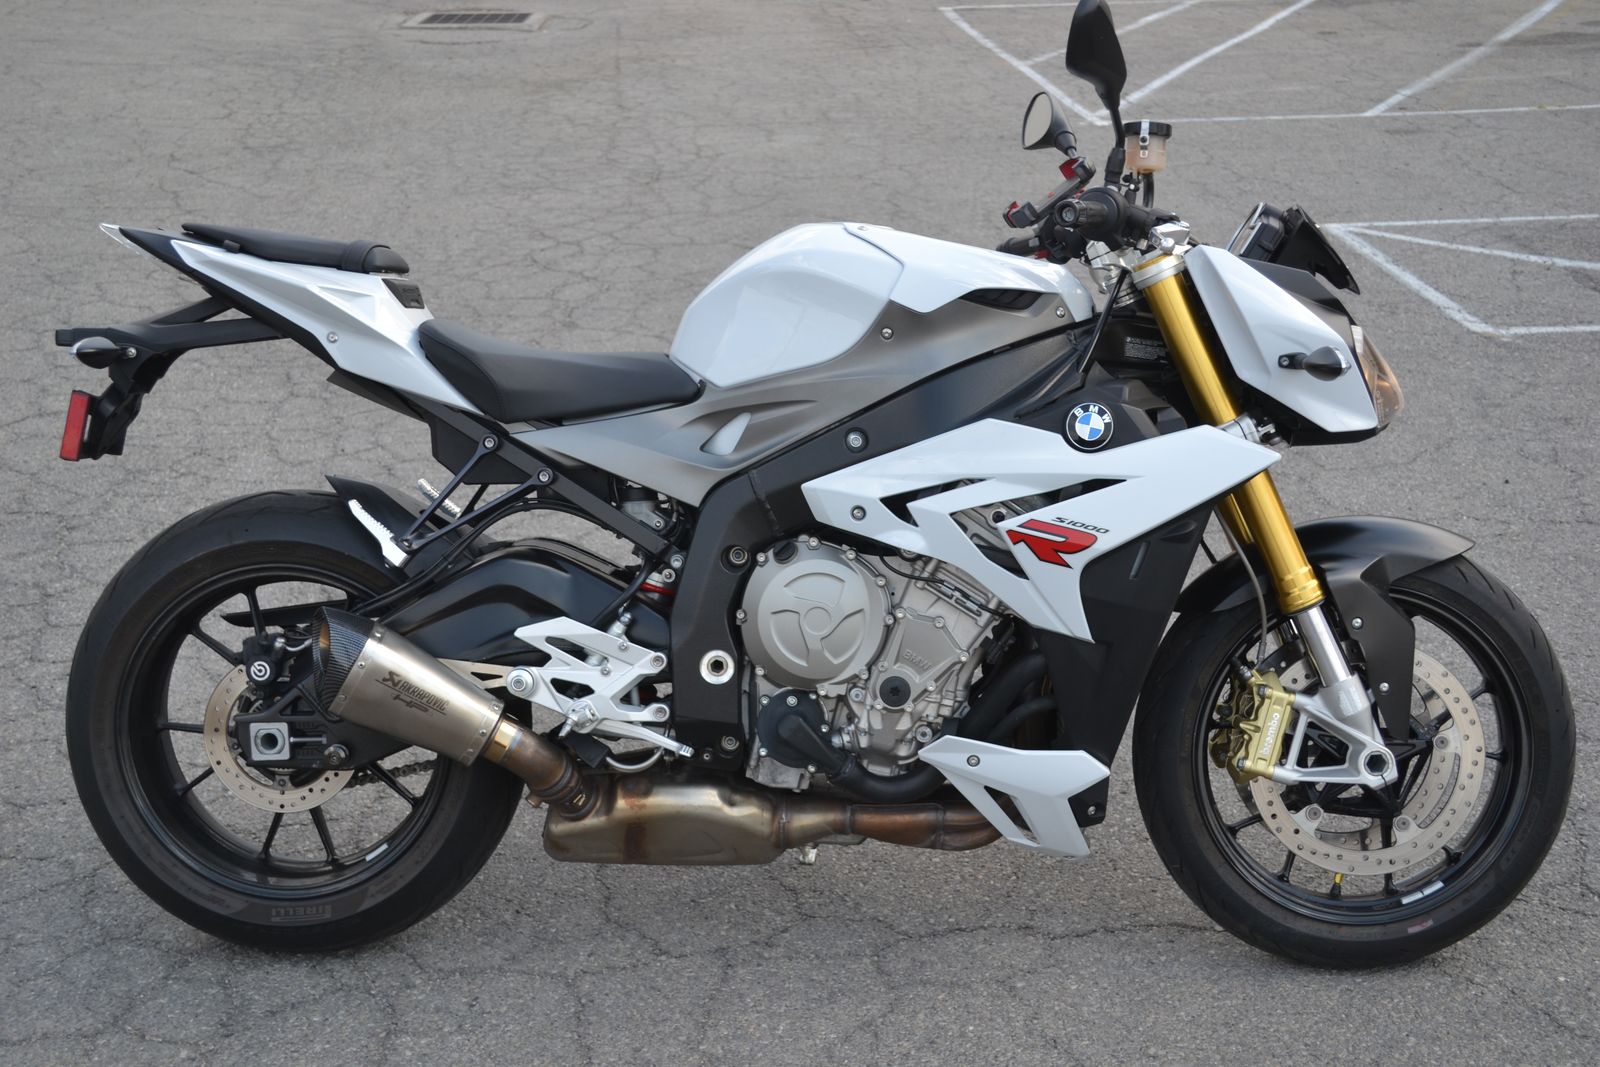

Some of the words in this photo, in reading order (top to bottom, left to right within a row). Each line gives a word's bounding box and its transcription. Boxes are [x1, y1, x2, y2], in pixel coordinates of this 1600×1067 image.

[1073, 405, 1112, 423] BMW
[1051, 517, 1110, 534] S1000
[1260, 712, 1280, 755] brembo
[271, 905, 332, 922] PIRELLI
